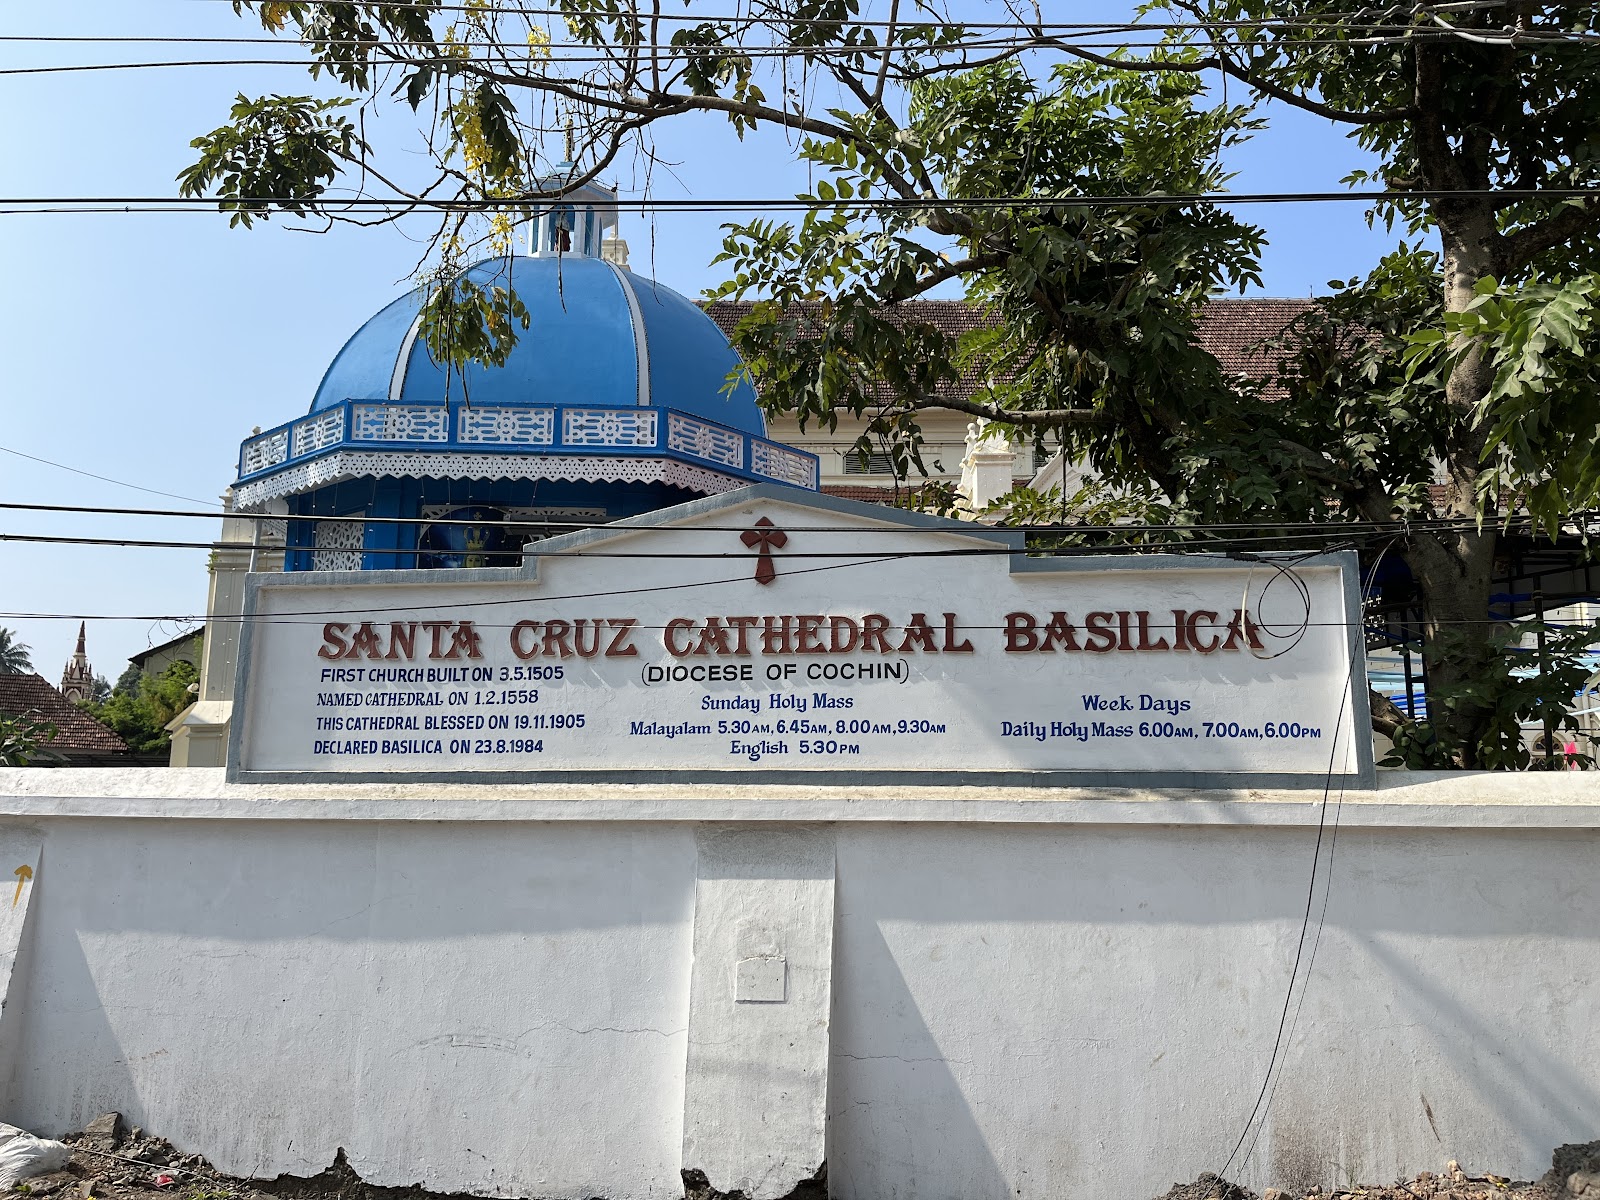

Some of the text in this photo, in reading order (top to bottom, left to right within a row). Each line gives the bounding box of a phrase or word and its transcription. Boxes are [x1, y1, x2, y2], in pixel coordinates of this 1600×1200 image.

[319, 611, 1264, 659] SANTA CRUZ CATHEDRAL BASILICA
[320, 665, 564, 683] FIRST CHURCH BUILT ON 3.5.1505
[641, 658, 910, 687] (DIOCESE OF COCHIN)
[316, 689, 539, 707] NAMED CATHEDRAL ON 1.2.1558
[701, 692, 854, 714] Sunday Holy Mass
[1081, 694, 1192, 716] Week Days
[316, 713, 586, 731] THIS CATHEDRAL BLESSED ON 19.11.1905
[629, 720, 712, 740] Malayalam
[1000, 721, 1047, 742] Daily
[1049, 721, 1089, 743] Holy
[1090, 721, 1134, 738] Mass
[313, 739, 544, 755] DECLARED BASILICA ON 23.8.1984
[729, 740, 789, 762] English
